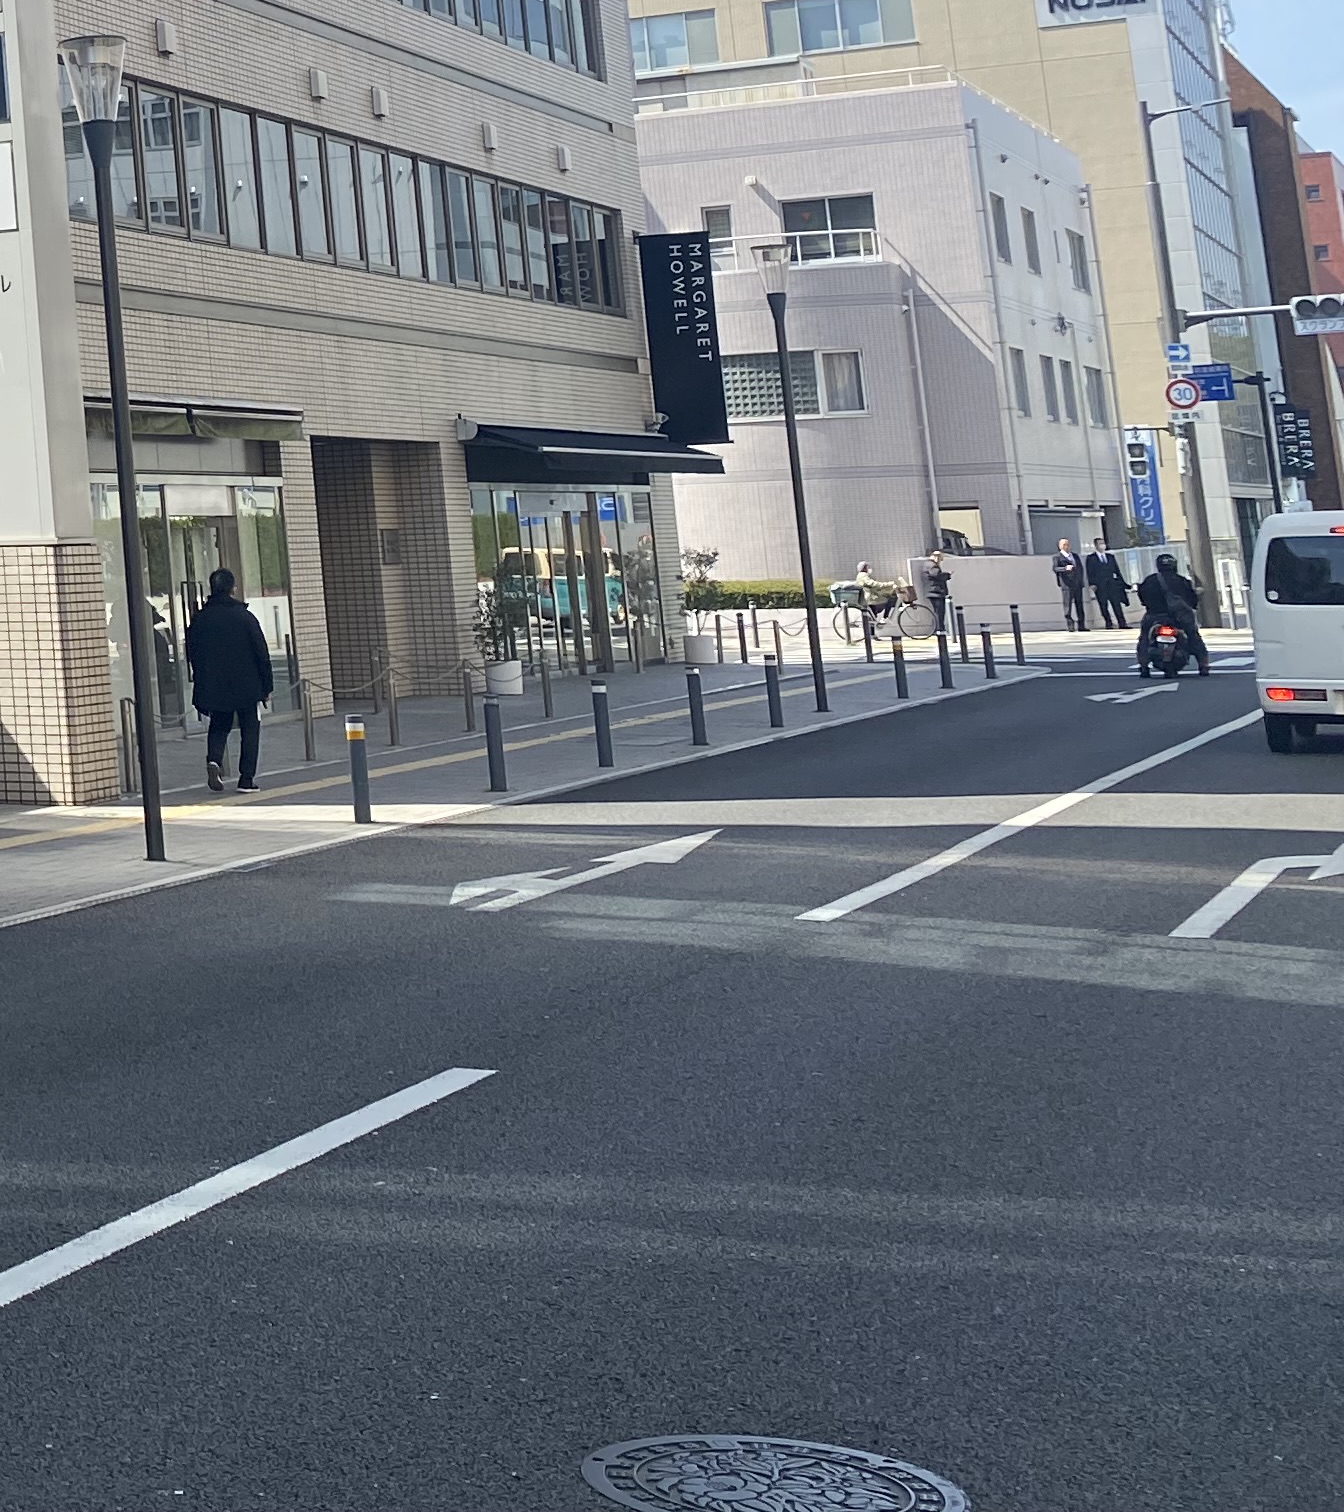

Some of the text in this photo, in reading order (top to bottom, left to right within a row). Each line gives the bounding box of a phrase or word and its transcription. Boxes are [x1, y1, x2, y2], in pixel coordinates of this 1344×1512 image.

[669, 244, 689, 335] HOWELL
[688, 243, 713, 362] MARGARET
[1173, 387, 1193, 401] 30
[1297, 419, 1315, 470] BRERA
